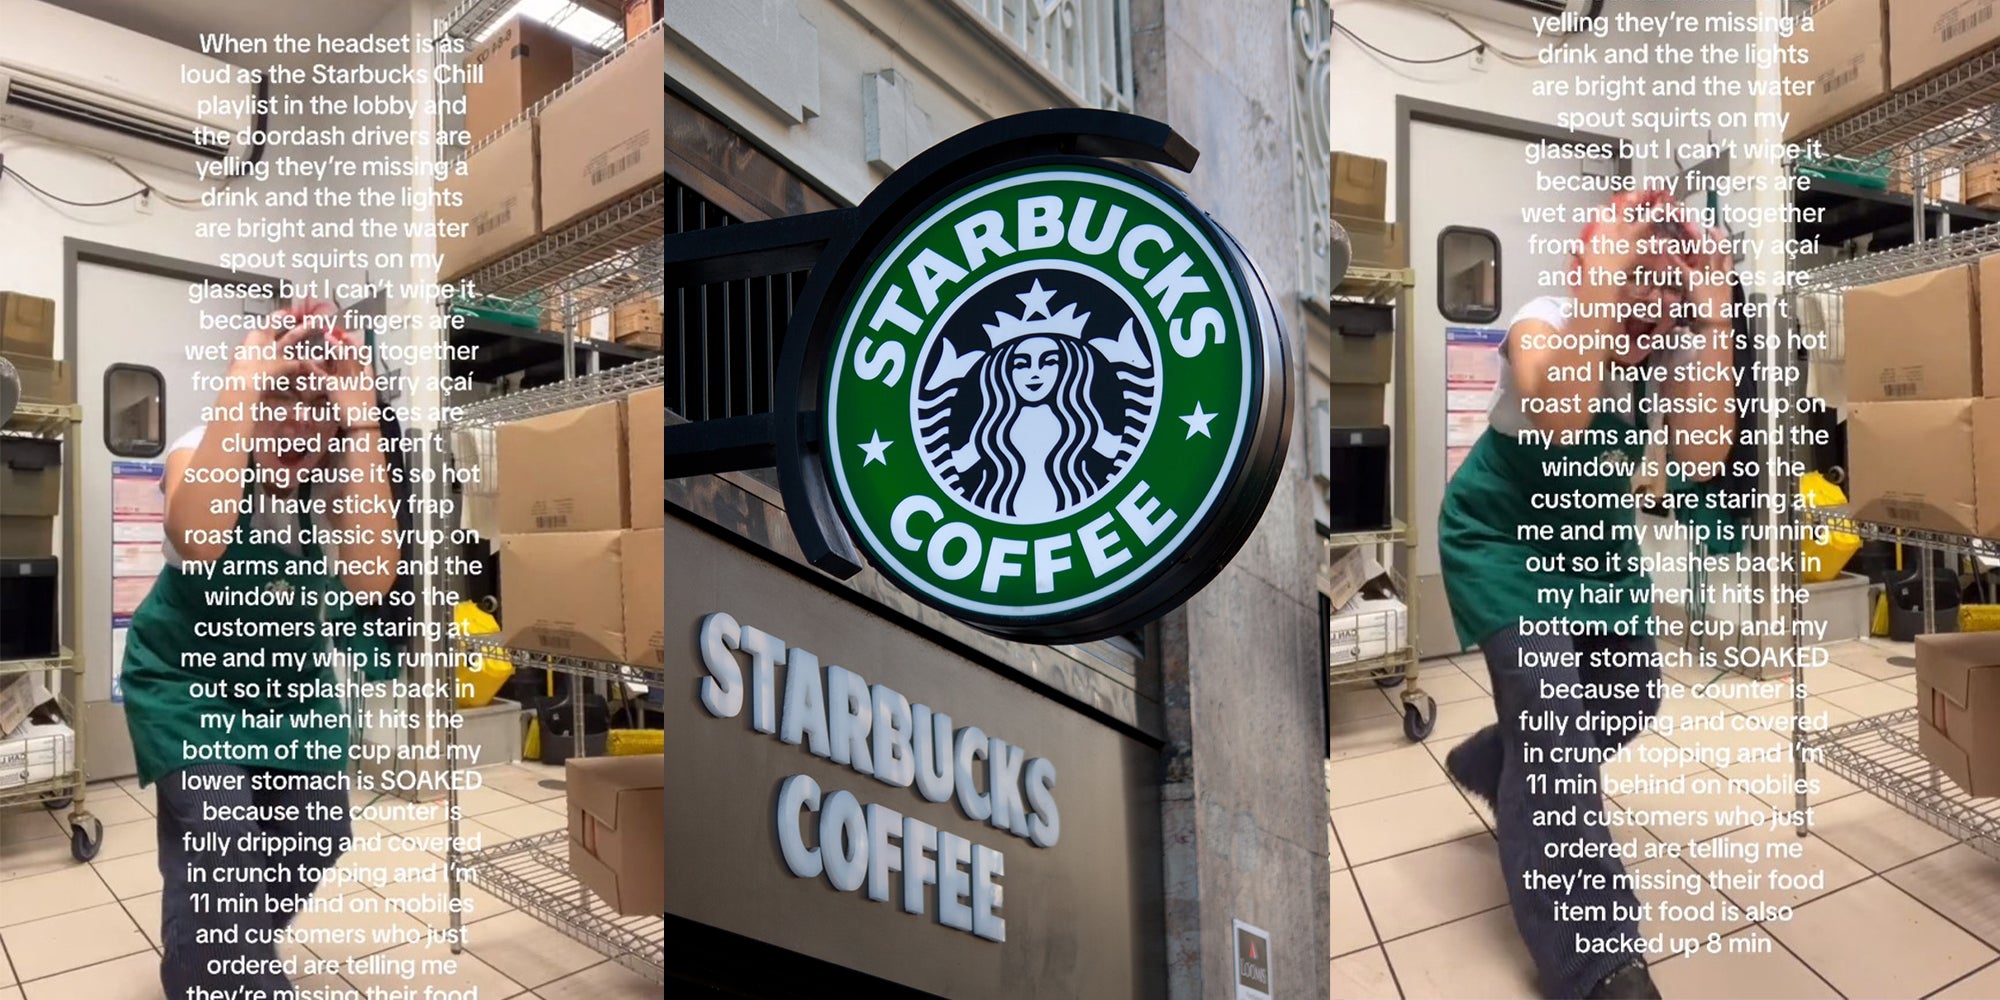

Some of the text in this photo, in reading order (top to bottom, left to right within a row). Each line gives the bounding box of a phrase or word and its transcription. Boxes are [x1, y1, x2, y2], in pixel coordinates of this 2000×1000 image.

[853, 194, 1226, 388] STARBUCKS
[890, 480, 1178, 594] COFFEE
[700, 612, 1060, 848] STARBUCKS
[776, 774, 1006, 943] COFFEE
